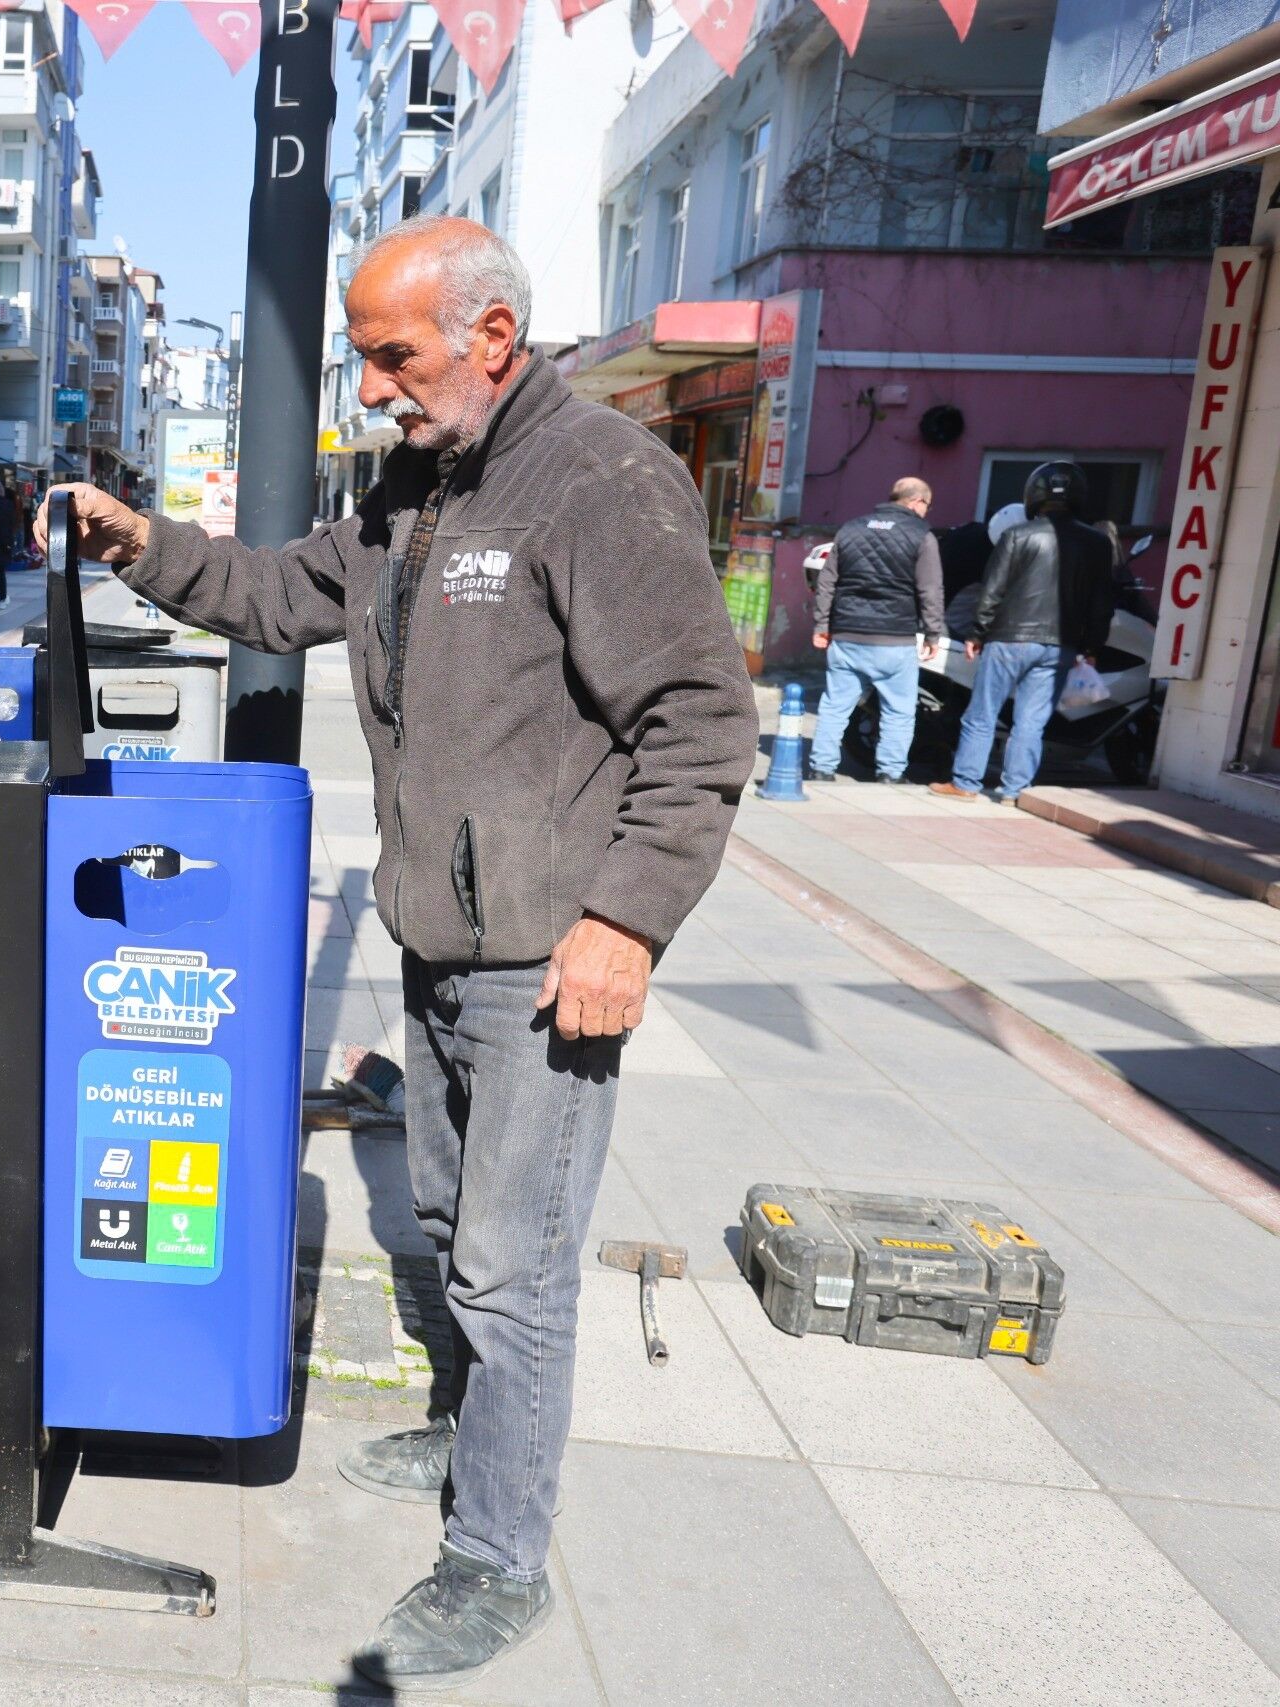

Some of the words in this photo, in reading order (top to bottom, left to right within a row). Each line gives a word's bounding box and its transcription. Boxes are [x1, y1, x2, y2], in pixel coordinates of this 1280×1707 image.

[1078, 121, 1207, 200] ÖZLEM
[1171, 261, 1252, 667] YUFKACI
[135, 954, 160, 963] GURUR
[161, 954, 199, 965] HEPİMİZİN
[121, 1025, 171, 1037] Geleceğin
[174, 1027, 204, 1038] İncisi
[132, 1066, 177, 1085] GERİ
[86, 1083, 223, 1108] DÖNÜŞEBİLEN
[112, 1109, 195, 1128] ATIKLAR
[94, 1179, 118, 1190] Kağıt
[118, 1180, 137, 1190] Atık
[90, 1239, 117, 1249] Metal
[118, 1240, 137, 1250] Atık
[182, 1243, 207, 1255] Atık
